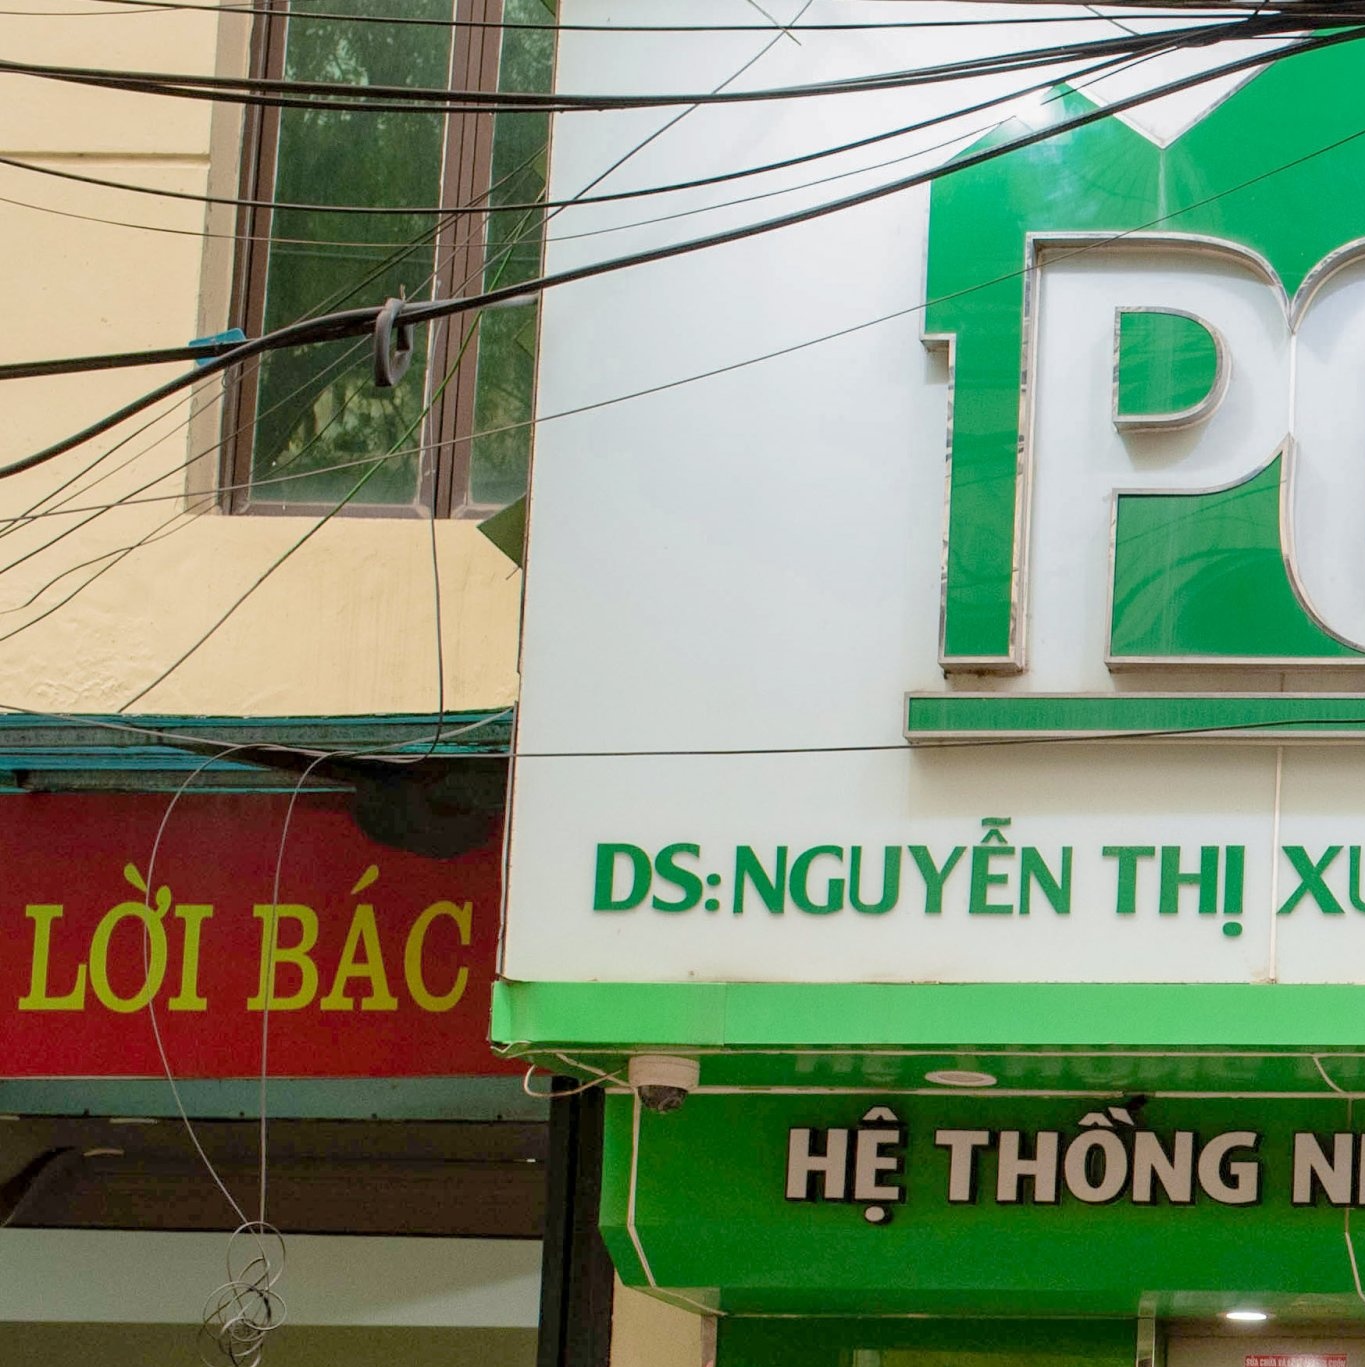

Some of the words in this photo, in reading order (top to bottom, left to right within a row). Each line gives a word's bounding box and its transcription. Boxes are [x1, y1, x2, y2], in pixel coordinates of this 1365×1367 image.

[17, 862, 214, 1014] LỜI
[246, 864, 473, 1014] BÁC
[1102, 845, 1246, 938] THỊ
[785, 1106, 904, 1226] HỆ
